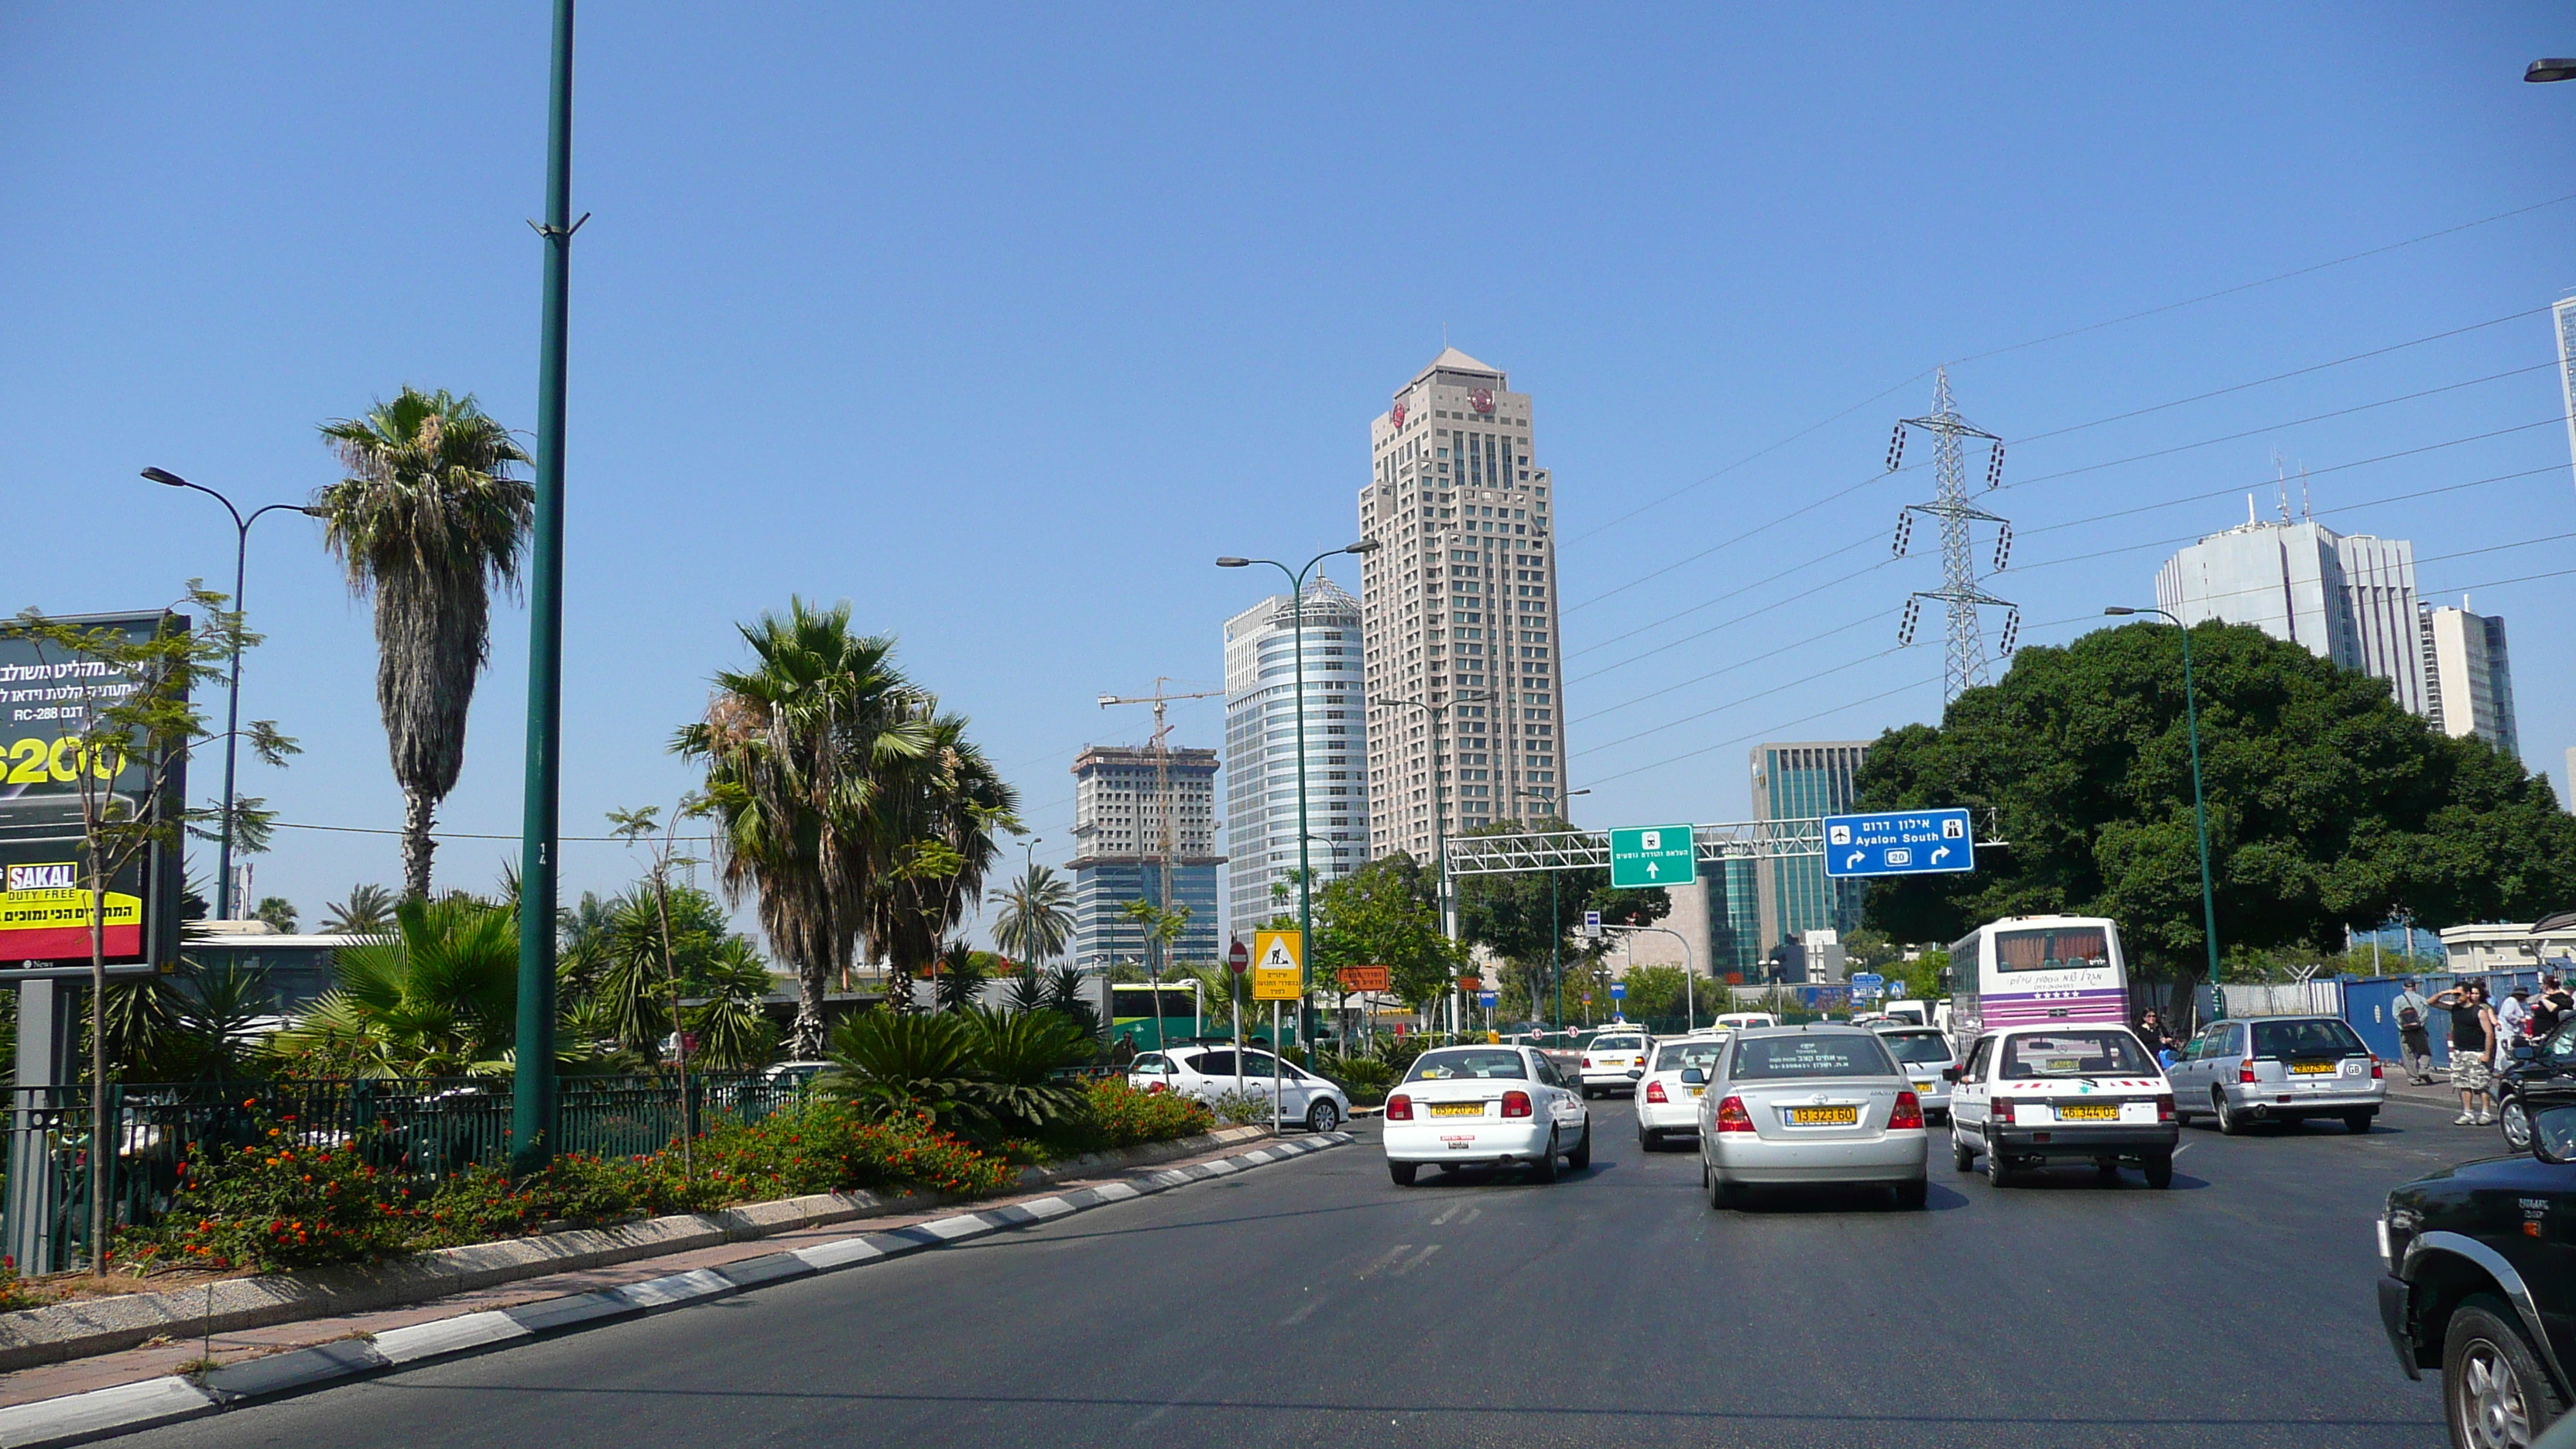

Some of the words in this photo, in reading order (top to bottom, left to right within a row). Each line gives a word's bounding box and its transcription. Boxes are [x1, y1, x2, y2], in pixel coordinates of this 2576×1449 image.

[0, 663, 52, 682] משולב
[55, 659, 105, 678] מקליט
[12, 688, 43, 702] וידאו
[46, 684, 84, 702] קלטת
[14, 707, 58, 721] RC-288
[61, 706, 84, 719] דגם
[1862, 820, 1890, 832] דרום
[1898, 819, 1930, 831] אילון
[1855, 835, 1896, 847] Ayalon
[1903, 832, 1939, 844] South
[1892, 853, 1905, 862] 20
[11, 865, 74, 890] SAKAL
[9, 890, 38, 901] DUTY
[45, 889, 75, 899] FREE
[4, 909, 48, 922] נמוכים
[50, 909, 73, 920] הכי
[2348, 1065, 2360, 1074] GB
[1797, 1110, 1809, 1121] 13
[1814, 1109, 1834, 1121] 323
[1838, 1109, 1852, 1120] 60
[2062, 1107, 2076, 1117] 46
[2079, 1107, 2099, 1117] 344
[2104, 1107, 2117, 1116] 03
